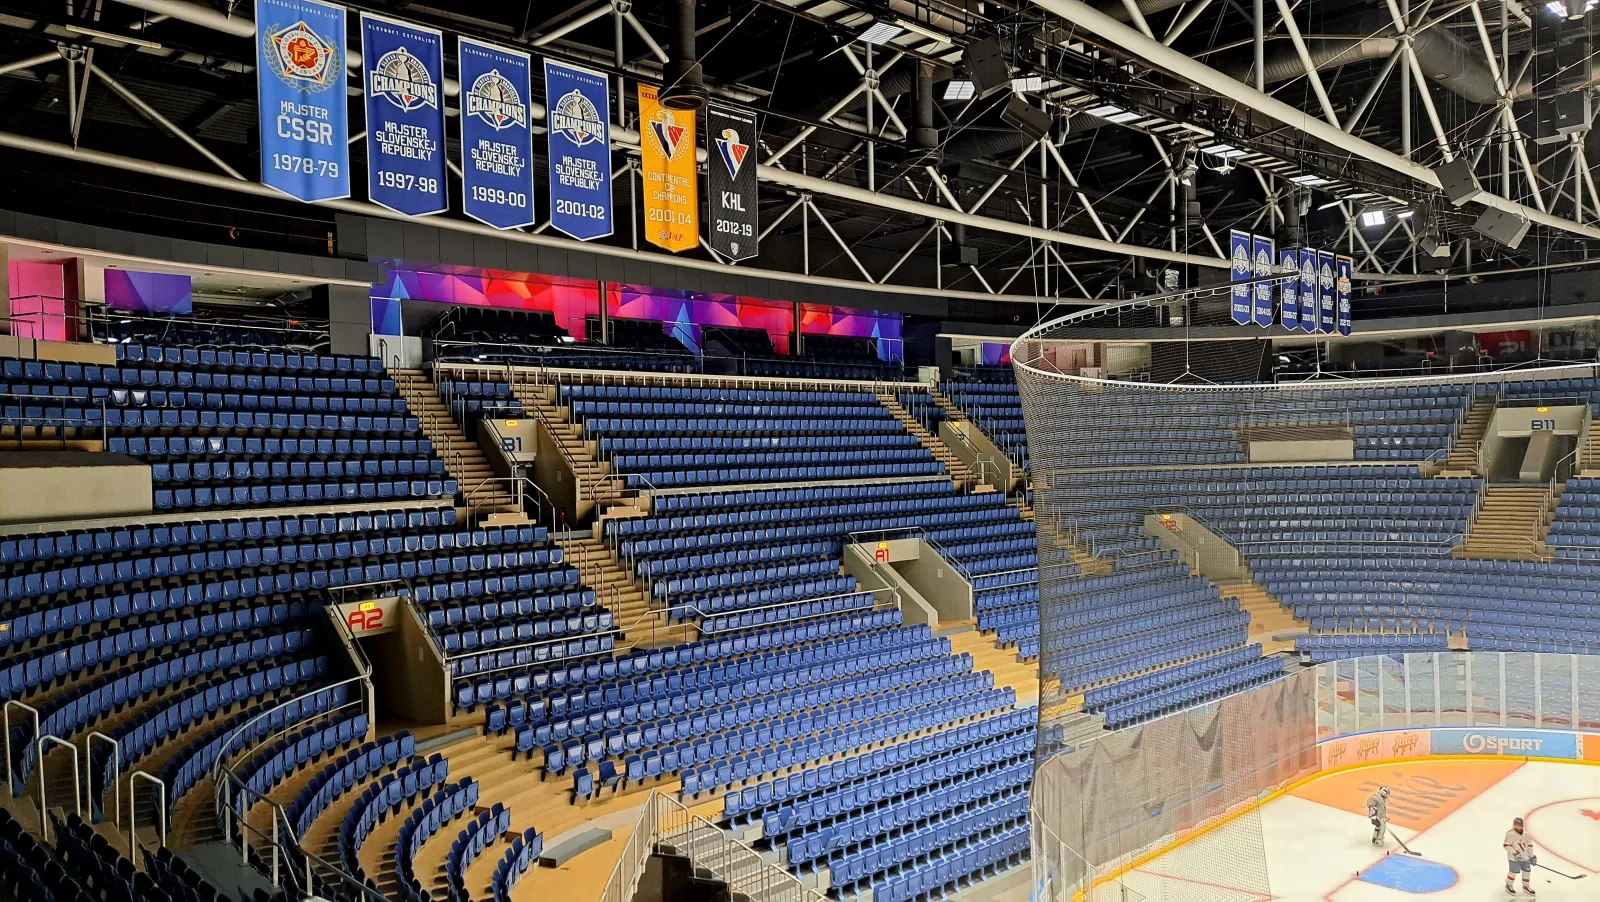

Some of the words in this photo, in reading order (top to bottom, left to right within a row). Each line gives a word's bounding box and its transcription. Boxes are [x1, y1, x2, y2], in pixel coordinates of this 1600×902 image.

[374, 75, 434, 104] CHAMPIONS
[280, 100, 328, 120] MAJSTER
[470, 96, 524, 122] CHAMPIONS
[277, 112, 332, 146] ČSSR
[385, 121, 428, 138] MAJSTER
[554, 114, 602, 139] CHAMPIONS
[376, 131, 436, 151] SLOVENSKEJ
[479, 139, 516, 156] MAJSTER
[382, 144, 432, 162] REPUBLIKY
[472, 148, 524, 168] SLOVENSKEJ
[562, 155, 596, 171] MAJSTER
[272, 153, 338, 178] 1978-79
[476, 160, 520, 177] REPUBLIKY
[556, 164, 604, 182] SLOVENSKEJ
[378, 170, 438, 194] 1997-98
[560, 174, 600, 190] REPUBLIKY
[472, 186, 526, 208] 1999-00
[722, 190, 746, 212] KHL
[556, 200, 604, 220] 2001-02
[716, 220, 752, 236] 2012-19
[1532, 420, 1556, 430] B11
[502, 436, 522, 452] B1
[876, 548, 888, 562] A1
[348, 608, 384, 630] A2
[1486, 736, 1544, 755] ŠPORT
